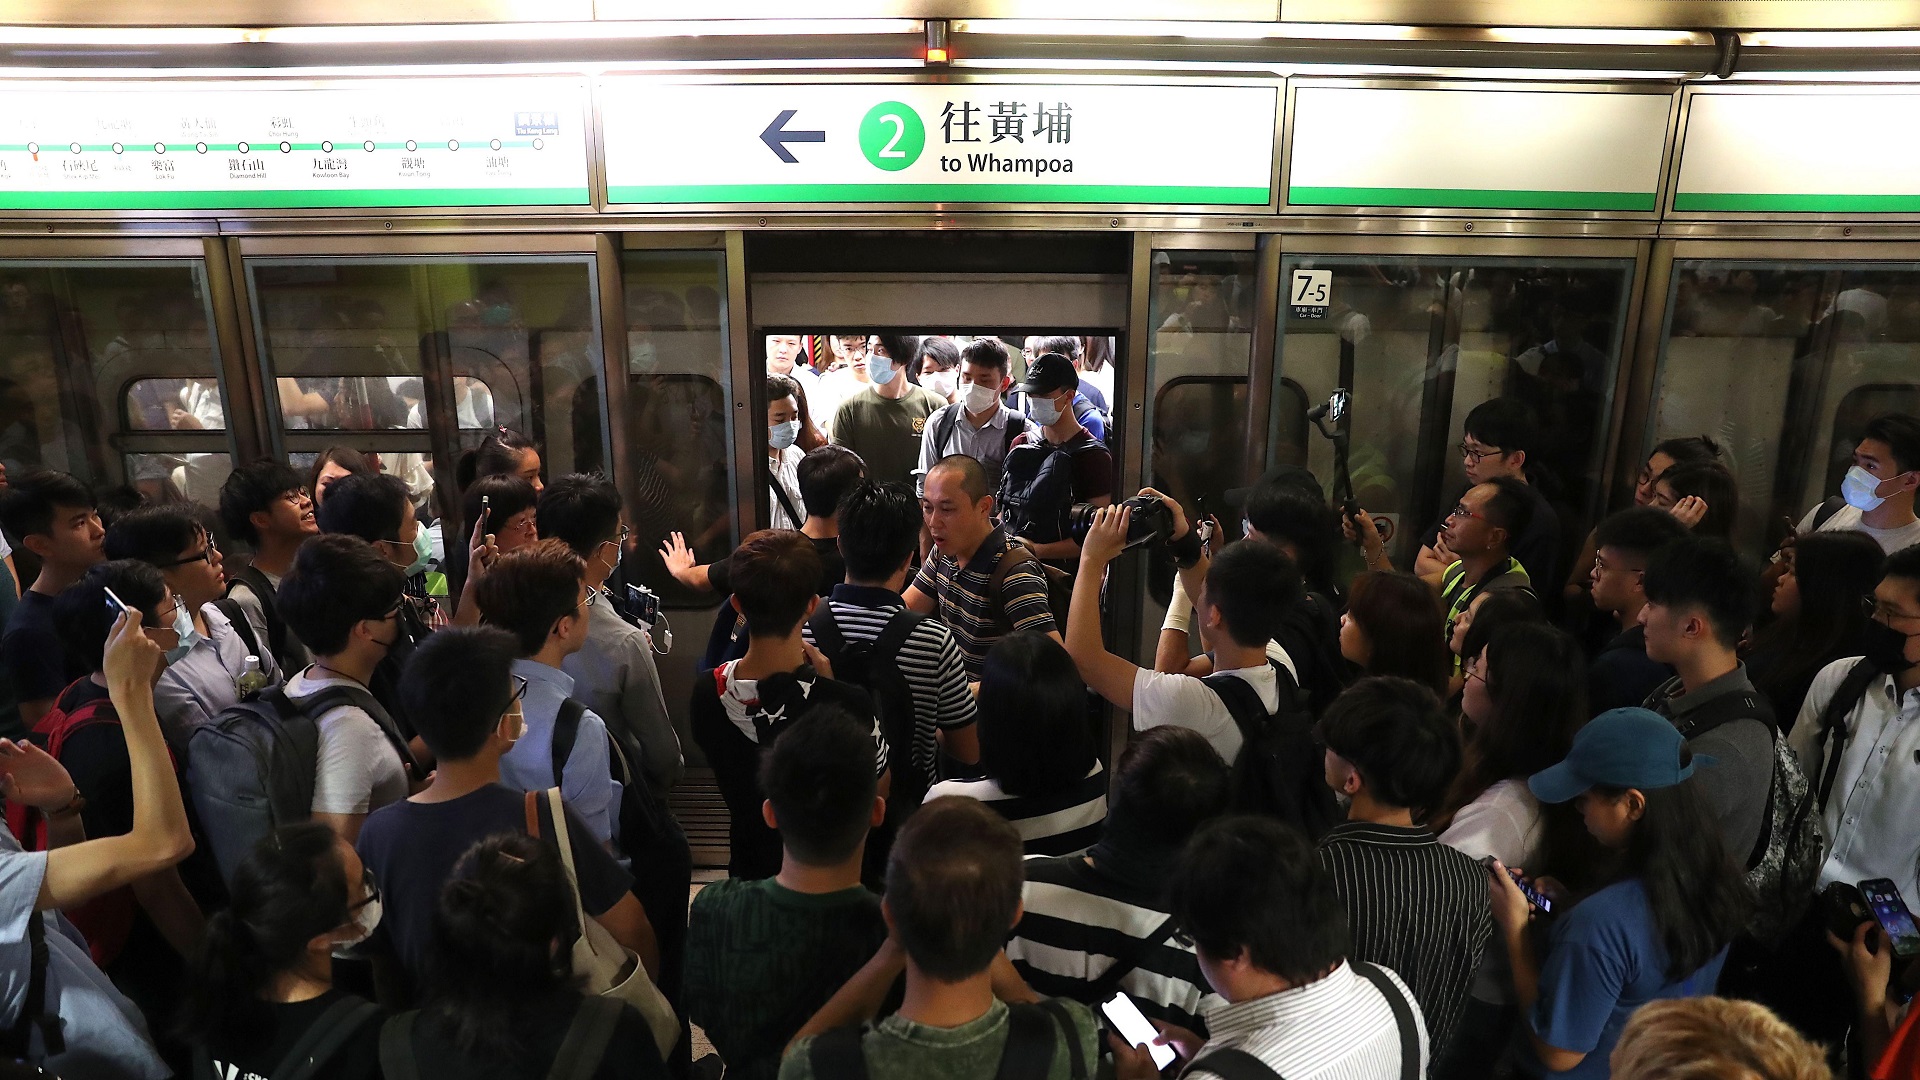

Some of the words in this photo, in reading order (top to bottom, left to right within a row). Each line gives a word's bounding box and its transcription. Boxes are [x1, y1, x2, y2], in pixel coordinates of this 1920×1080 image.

[940, 101, 1073, 144] 往黃埔
[878, 113, 906, 158] 2
[229, 172, 256, 180] Diamond
[338, 172, 350, 180] Bay
[940, 155, 962, 173] to
[967, 153, 1074, 177] Whampoa
[1297, 275, 1327, 302] 7-5
